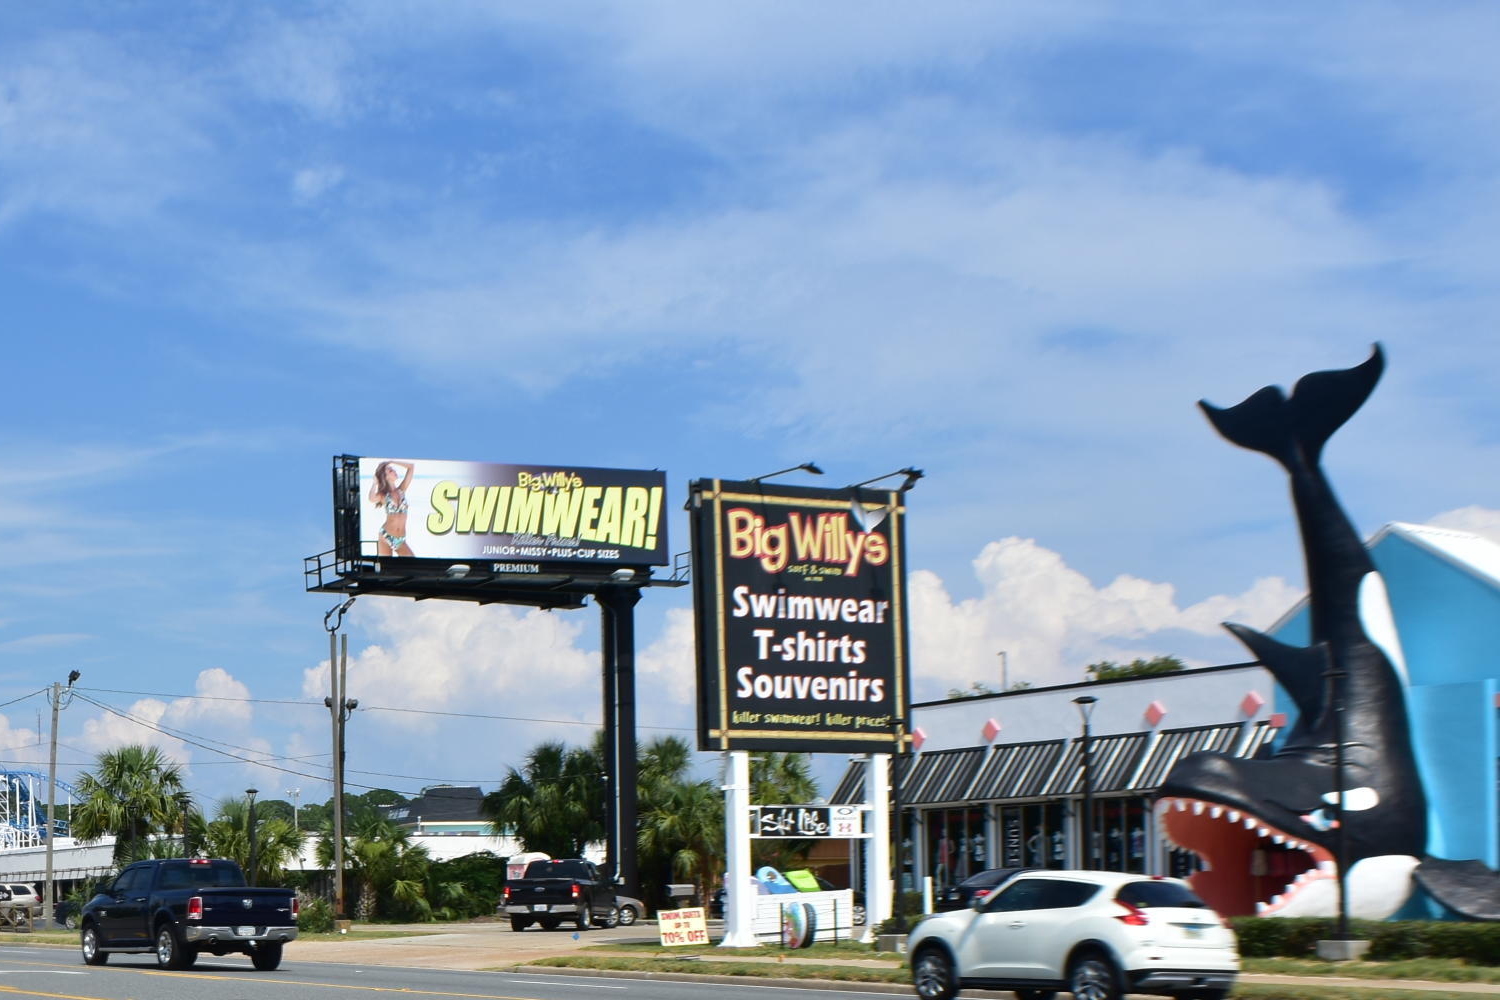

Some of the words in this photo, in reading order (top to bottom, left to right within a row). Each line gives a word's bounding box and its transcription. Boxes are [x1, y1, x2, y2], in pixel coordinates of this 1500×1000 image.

[518, 472, 542, 493] Big
[427, 481, 663, 550] SWIMWEAR!
[482, 545, 516, 556] JUNIOR
[520, 546, 547, 557] MISSY
[552, 547, 573, 558] PLUS
[577, 548, 596, 559] CUP
[597, 549, 620, 560] SIZES
[726, 507, 790, 574] Big
[493, 563, 539, 574] PREMIUM
[732, 586, 888, 623] Swimwear
[753, 629, 866, 664] T-shirts
[736, 666, 884, 703] Souvenirs
[732, 711, 761, 725] killer
[825, 713, 853, 727] killer
[661, 931, 685, 944] 70%
[687, 930, 706, 942] OFF
